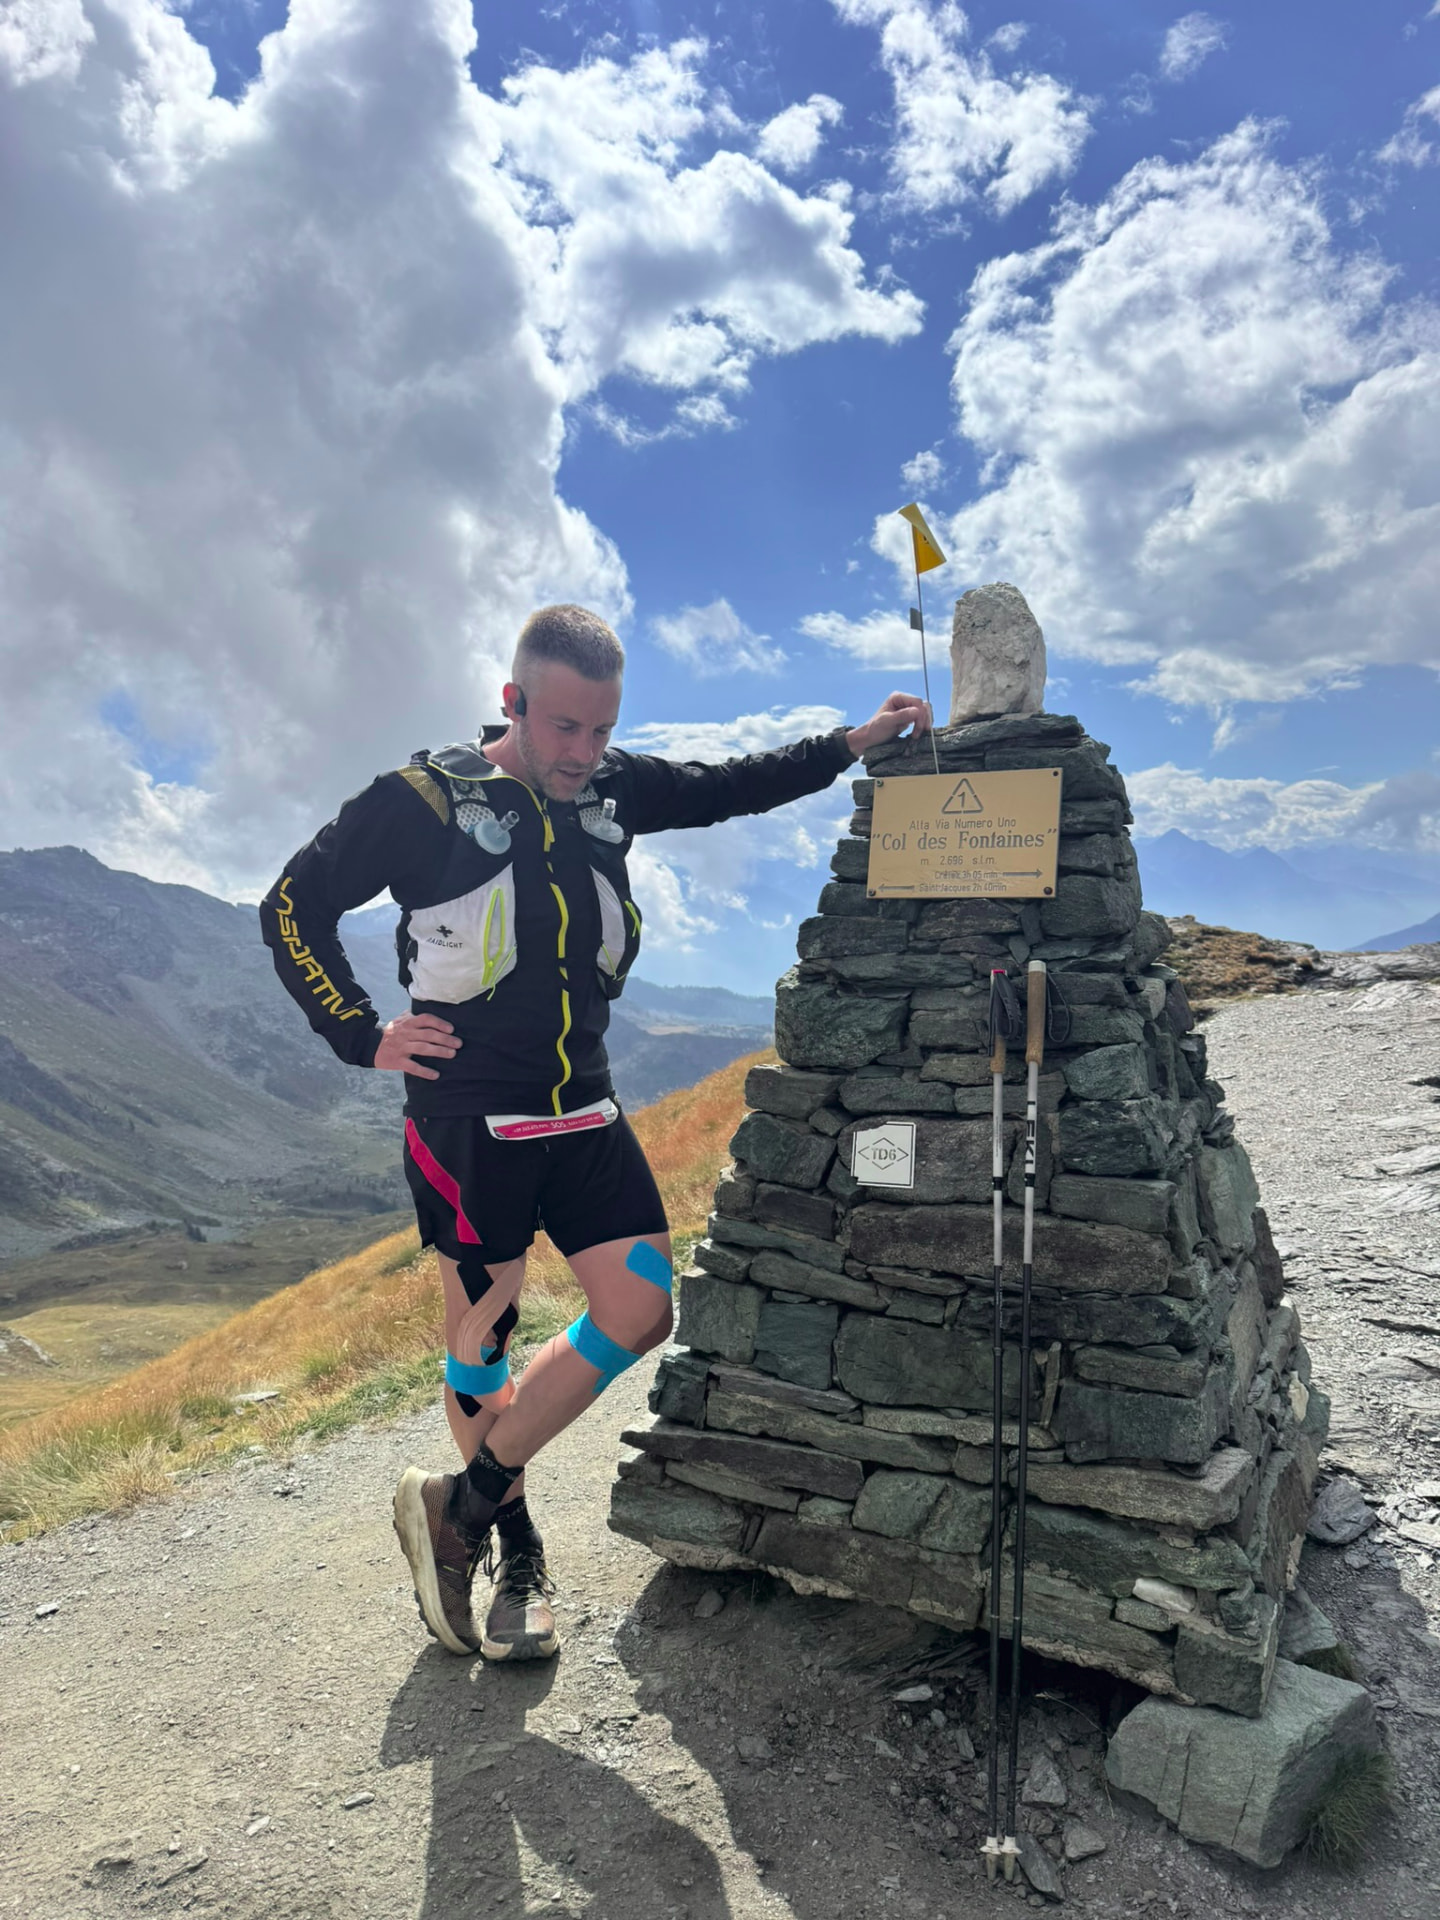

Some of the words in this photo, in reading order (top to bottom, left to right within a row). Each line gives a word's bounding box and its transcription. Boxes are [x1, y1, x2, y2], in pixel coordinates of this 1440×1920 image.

[957, 791, 966, 808] 1
[935, 818, 950, 830] Via
[955, 818, 993, 830] Numero
[998, 817, 1017, 828] Uno
[917, 832, 947, 850] des
